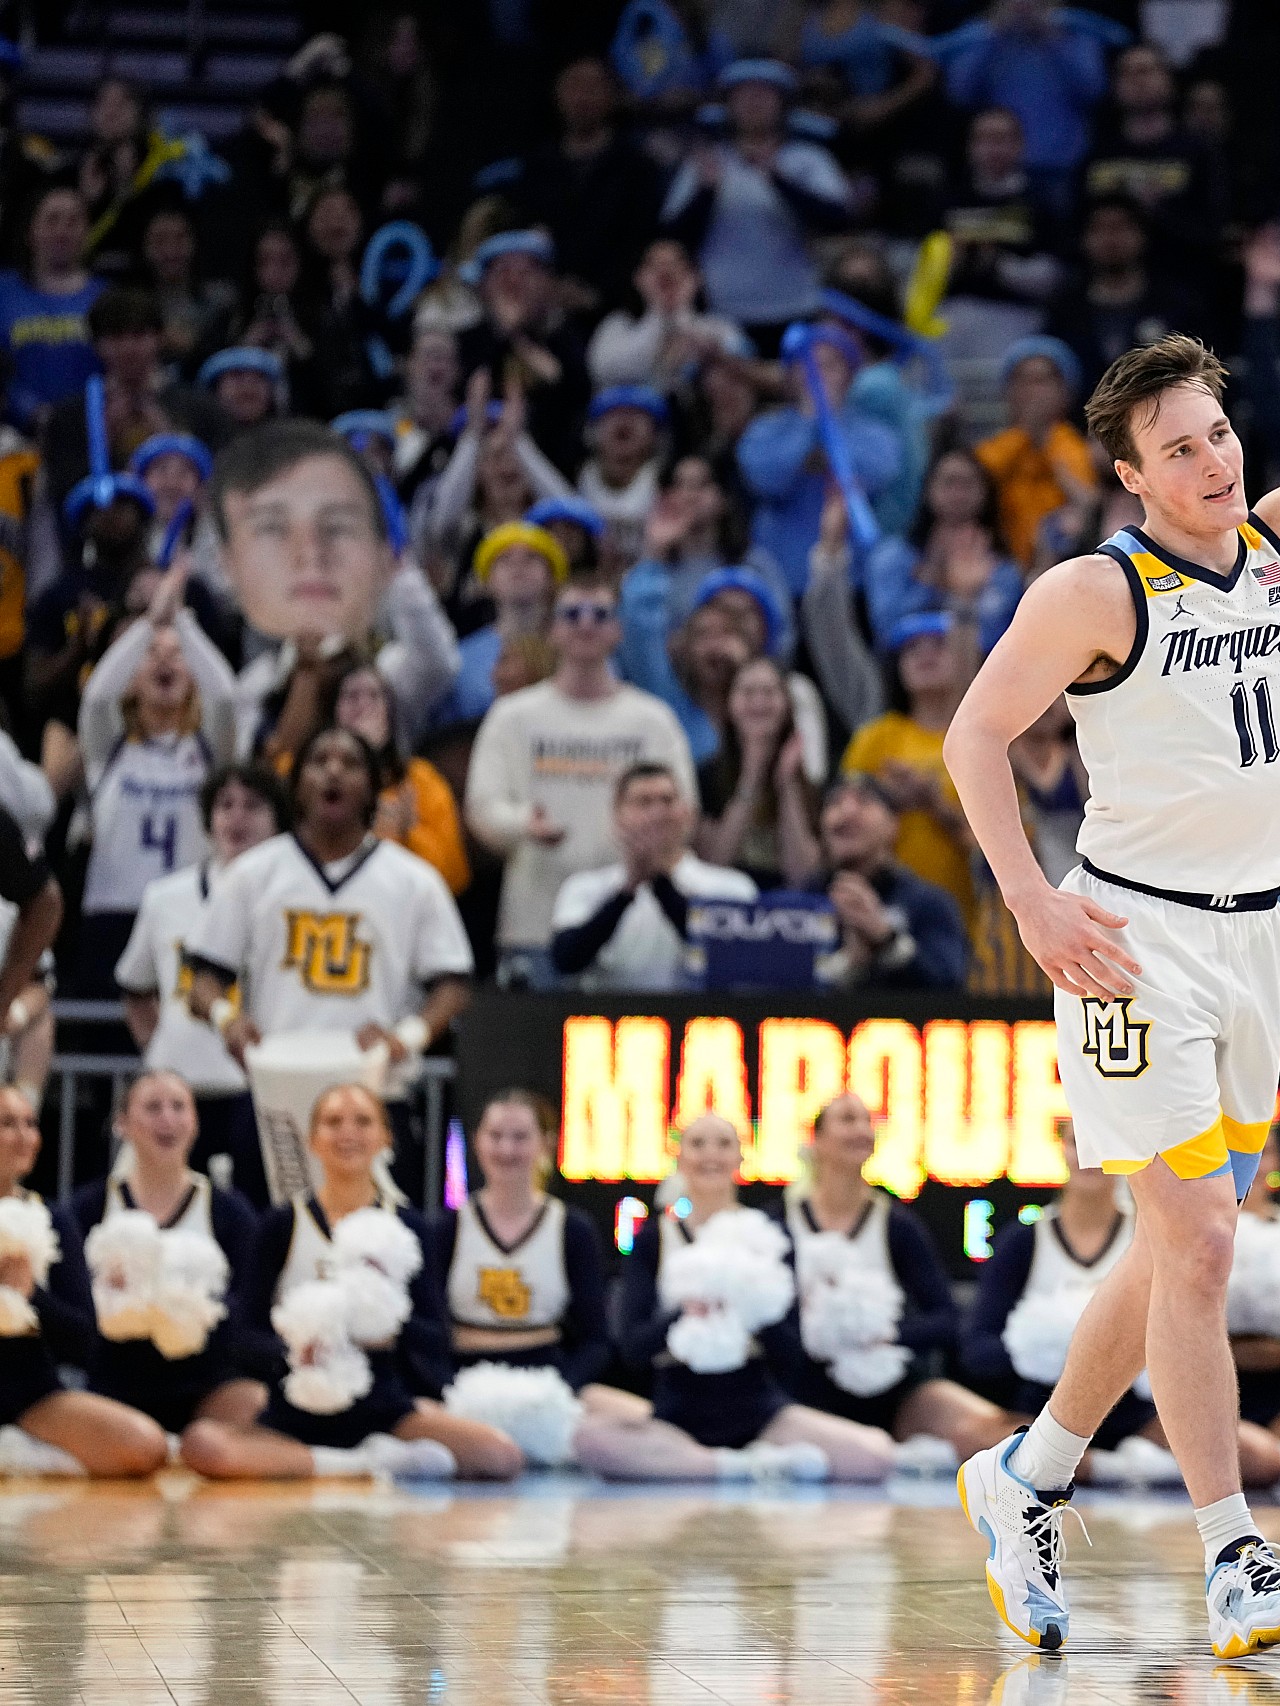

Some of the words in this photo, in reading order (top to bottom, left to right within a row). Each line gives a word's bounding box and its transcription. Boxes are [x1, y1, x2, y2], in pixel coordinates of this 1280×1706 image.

[1229, 676, 1280, 768] 11
[140, 812, 177, 873] 4
[282, 906, 372, 999] MU
[1081, 995, 1154, 1081] MU
[557, 1015, 1073, 1203] MARQUE
